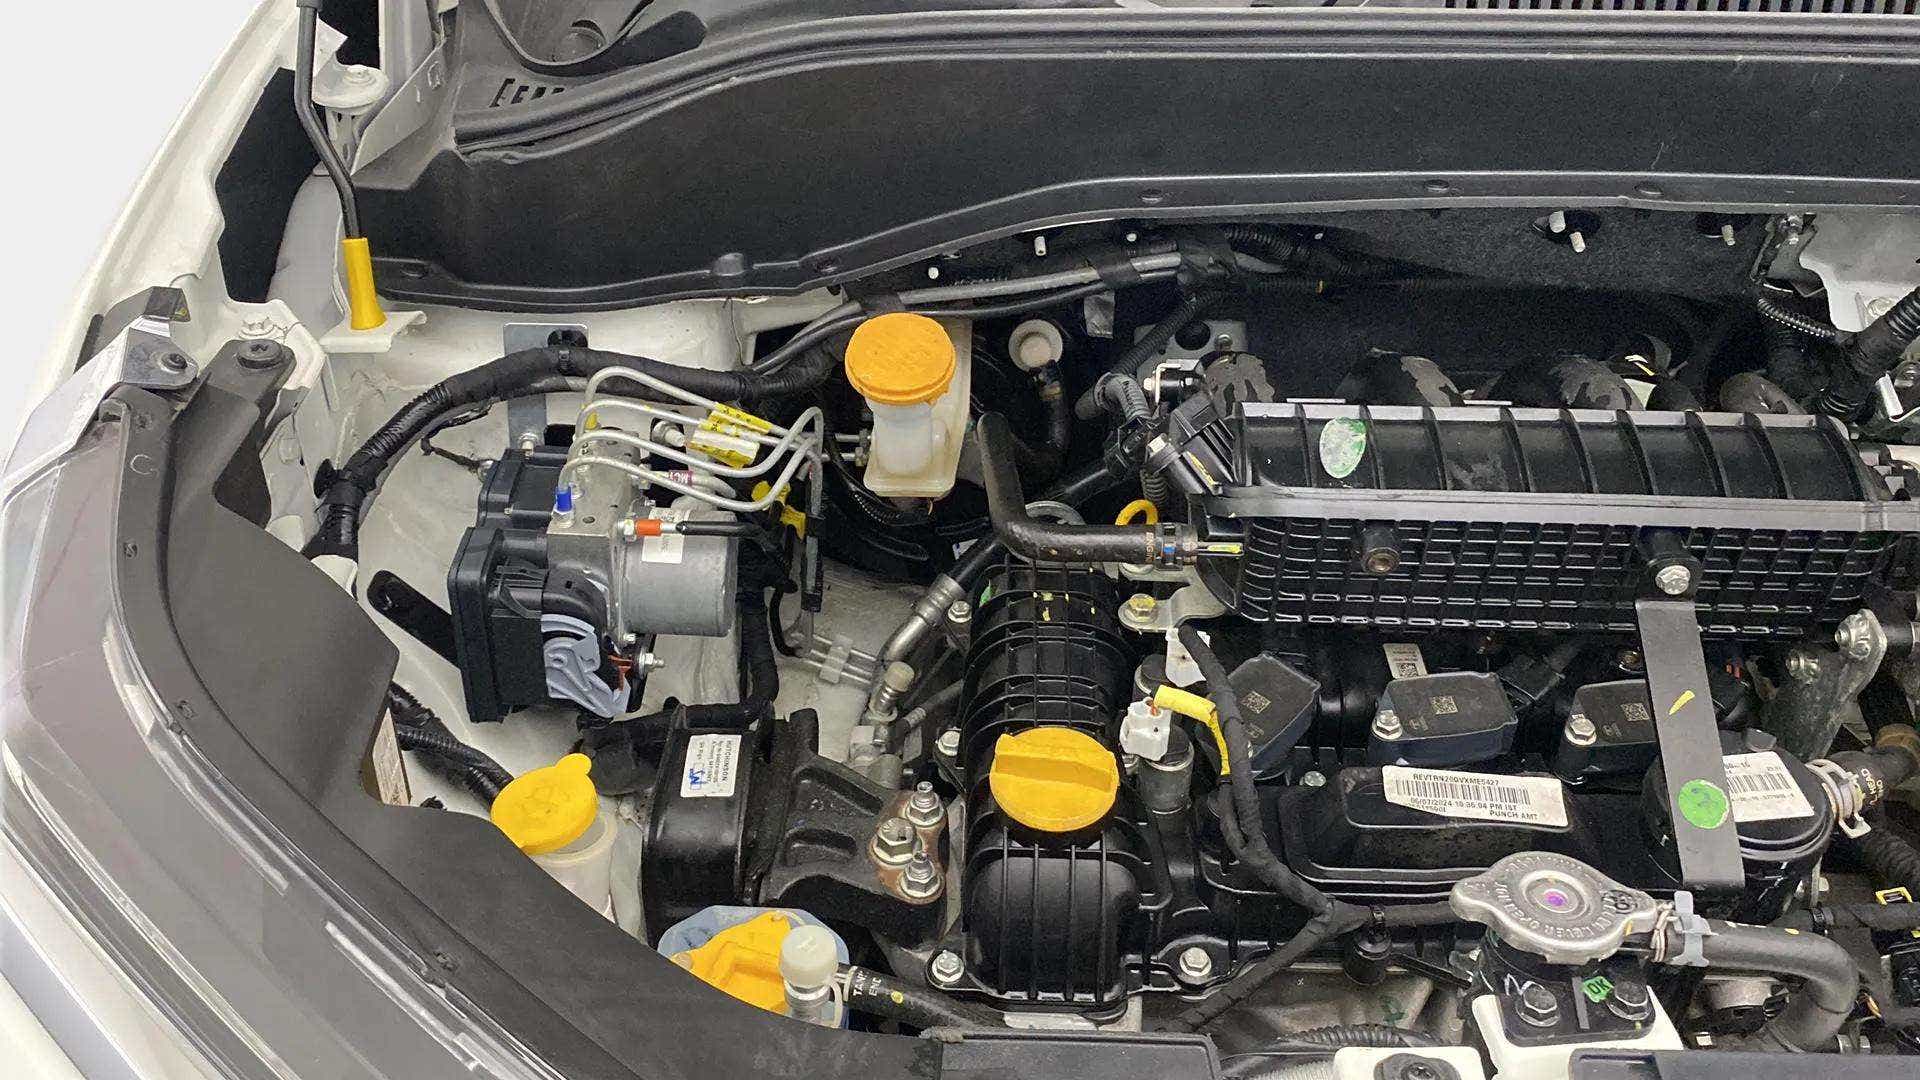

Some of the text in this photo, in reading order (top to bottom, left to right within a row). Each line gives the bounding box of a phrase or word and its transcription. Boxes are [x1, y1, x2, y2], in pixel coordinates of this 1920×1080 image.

[1145, 532, 1154, 562] ENGIN
[1490, 810, 1518, 819] PUNCH
[1587, 978, 1610, 995] OK
